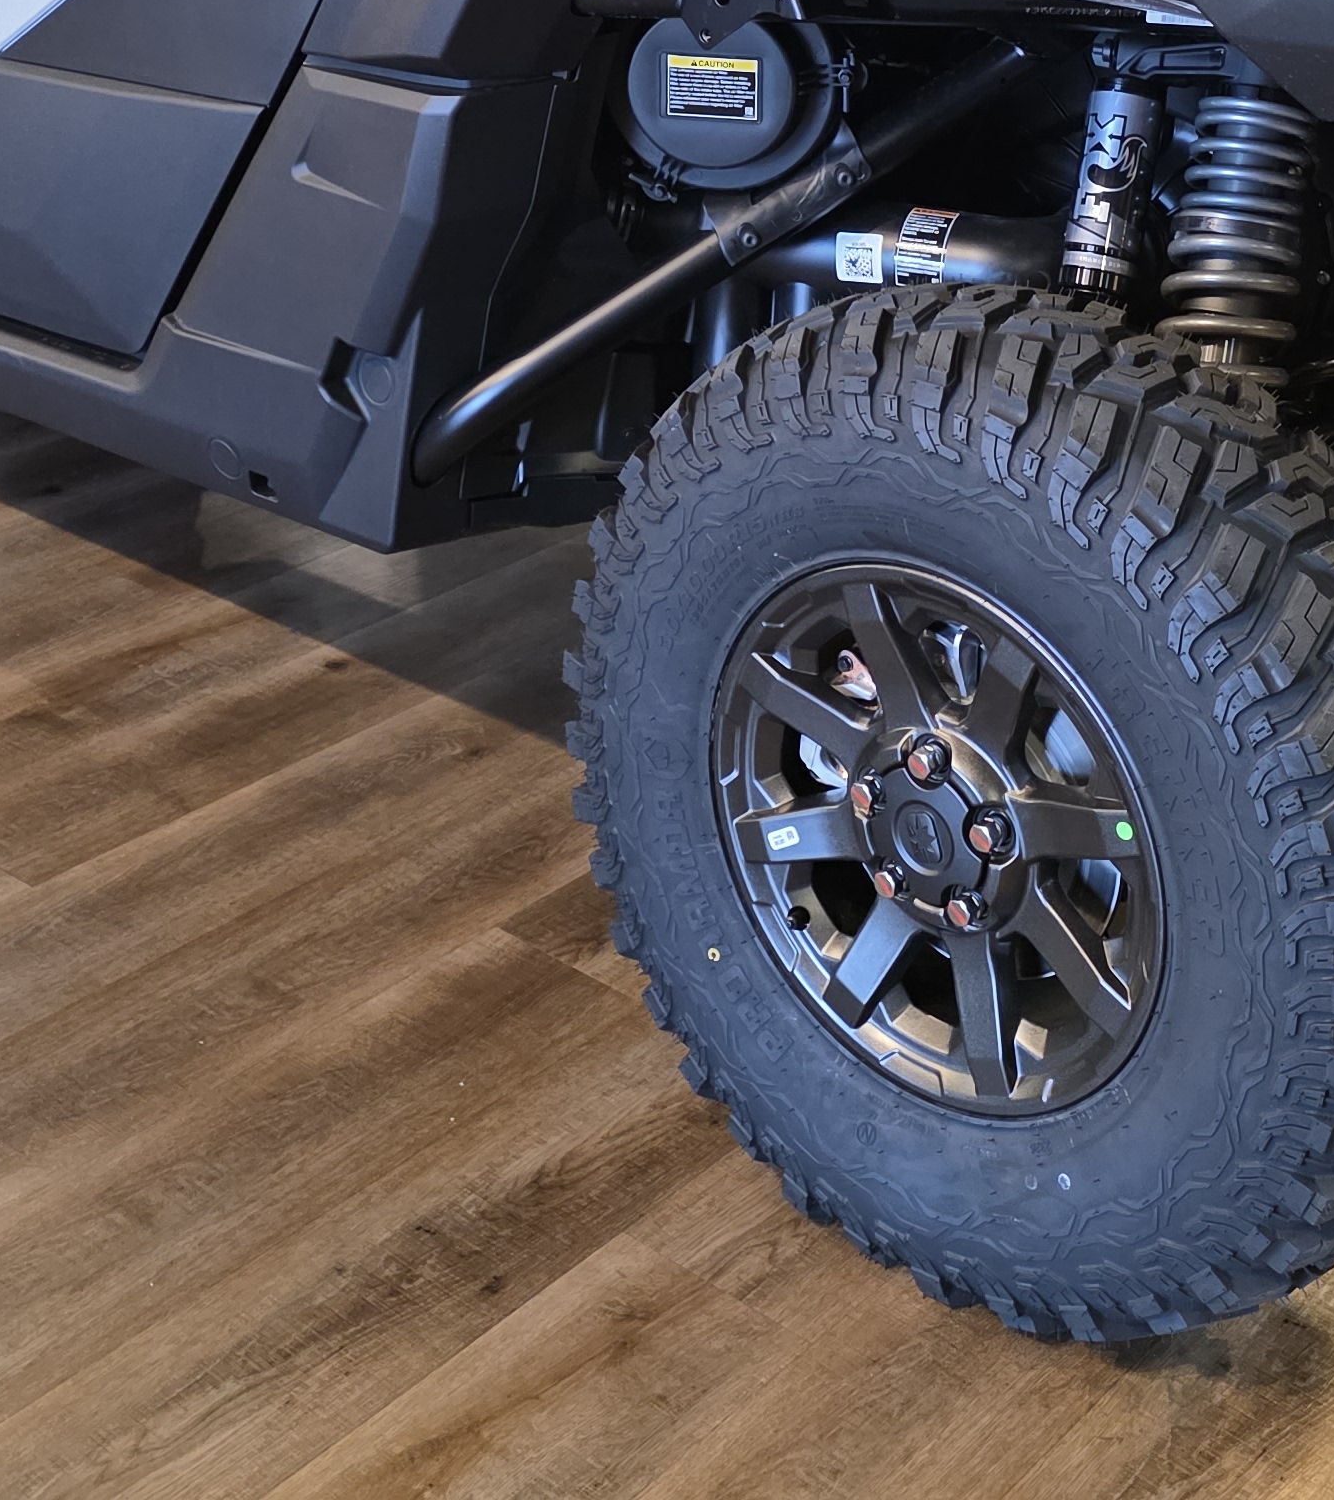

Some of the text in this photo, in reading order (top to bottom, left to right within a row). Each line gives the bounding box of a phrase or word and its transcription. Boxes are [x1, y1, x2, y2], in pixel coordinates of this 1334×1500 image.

[698, 60, 735, 69] CAUTION
[1073, 113, 1139, 223] FOX
[654, 790, 795, 1063] PRO ARMOR
